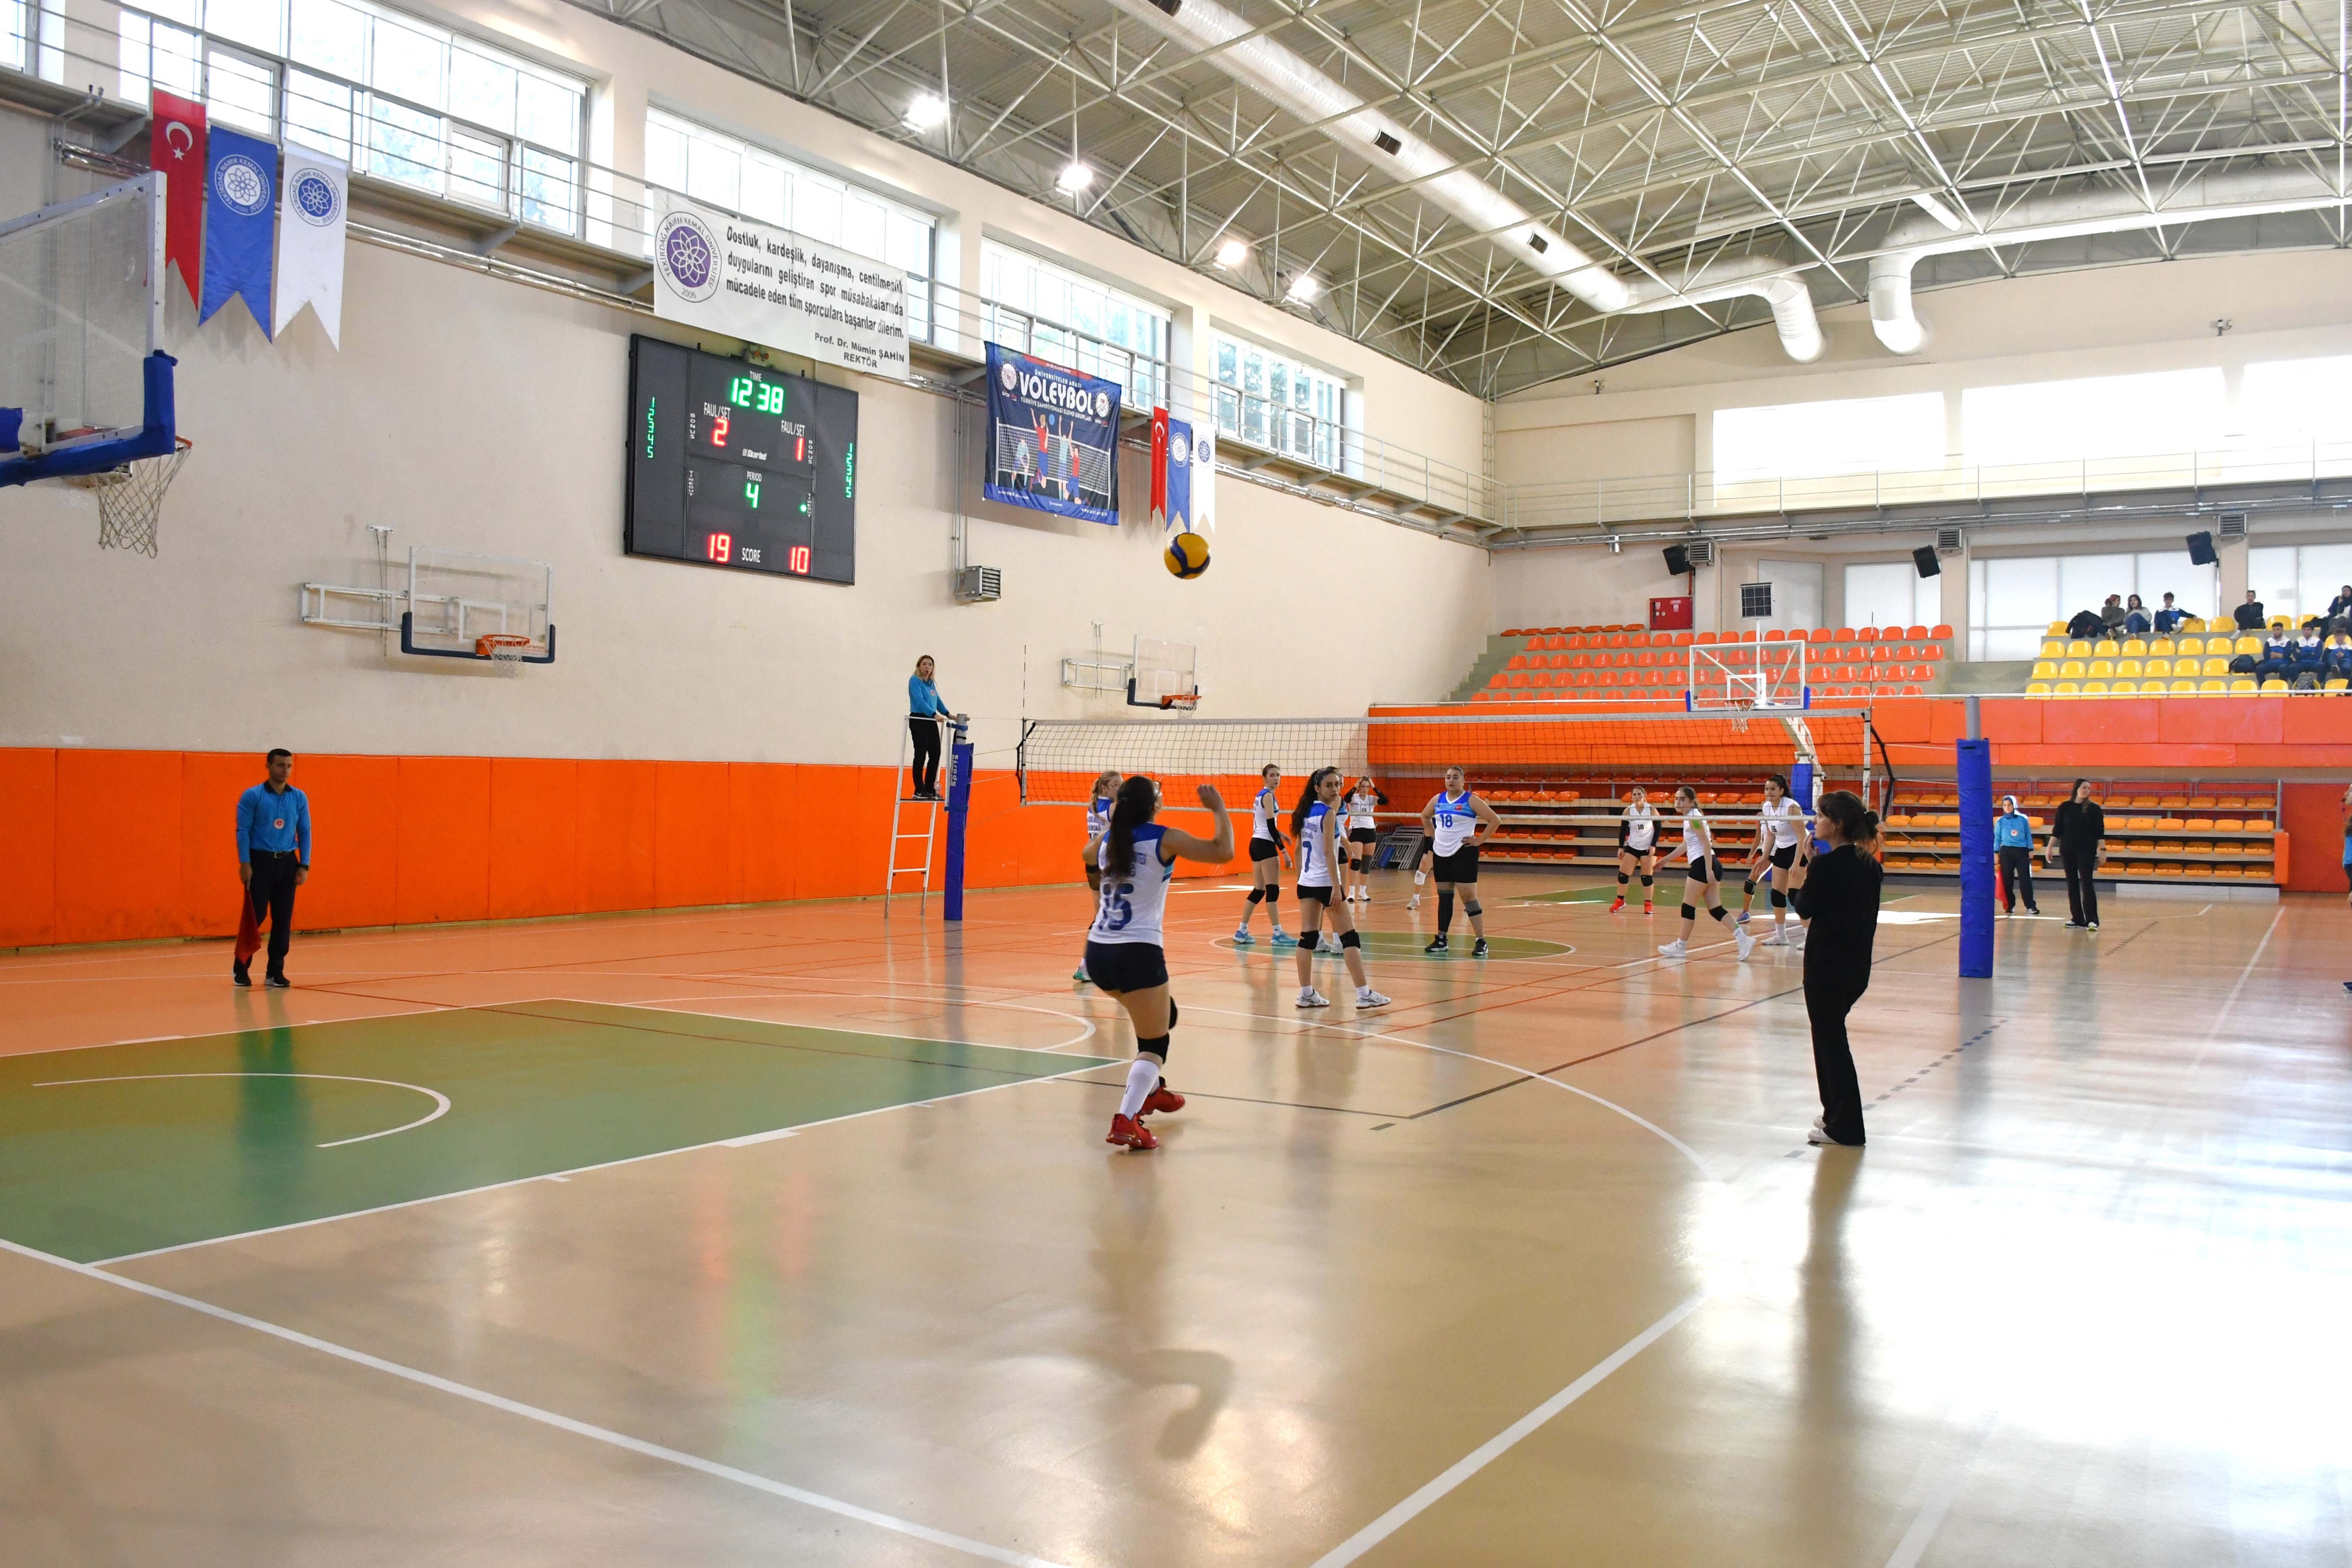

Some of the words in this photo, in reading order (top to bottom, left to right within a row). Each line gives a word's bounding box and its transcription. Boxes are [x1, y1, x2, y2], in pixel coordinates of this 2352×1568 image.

[220, 158, 238, 172] NAMIK
[239, 158, 259, 173] KEMAL
[295, 172, 312, 184] NAMIK
[312, 172, 331, 188] KEMAL
[664, 217, 684, 233] NAMIK
[684, 217, 705, 236] KEMAL
[659, 233, 672, 278] TEKİRDAĞ
[705, 235, 718, 290] ÜNİVERSİTESİ
[727, 225, 761, 254] Dostluk,
[767, 238, 807, 267] kardeşlik,
[811, 253, 854, 282] dayanışma,
[859, 271, 903, 294] centilmenlik
[681, 288, 696, 299] 2006
[728, 251, 773, 278] duygularını
[778, 268, 814, 291] geliştiren
[820, 282, 836, 298] spor
[841, 288, 903, 317] müsabakalarında
[726, 278, 766, 300] mücadele
[768, 288, 787, 306] eden
[789, 293, 803, 311] tüm
[804, 301, 843, 322] sporculara
[844, 310, 877, 330] başarılar
[877, 319, 904, 338] dilerim.
[814, 332, 834, 345] Prof.
[837, 337, 848, 348] Dr.
[851, 341, 877, 356] Mümin
[879, 349, 905, 363] ŞAHİN
[844, 352, 877, 368] REKTÖR
[749, 371, 762, 382] TIME
[1034, 368, 1068, 385] ÜNİVERSİTELER
[1068, 380, 1082, 389] ARASI
[1019, 371, 1094, 416] VOLEYBOL
[704, 402, 731, 420] FAUL/SET
[1020, 396, 1037, 407] TÜRKİYE
[1037, 401, 1063, 413] ŞAMPİYONASI
[1063, 409, 1075, 417] ELEME
[1075, 413, 1092, 422] GRUPLARI
[712, 417, 728, 447] 2
[781, 420, 806, 437] FAUL/SET
[797, 437, 804, 461] 1
[747, 471, 762, 482] PERIOD
[746, 482, 760, 508] 4
[709, 534, 731, 563] 19
[741, 547, 761, 563] SCORE
[791, 546, 810, 573] 10
[1439, 814, 1453, 828] 18
[1302, 840, 1313, 873] 7
[1099, 883, 1134, 931] 15
